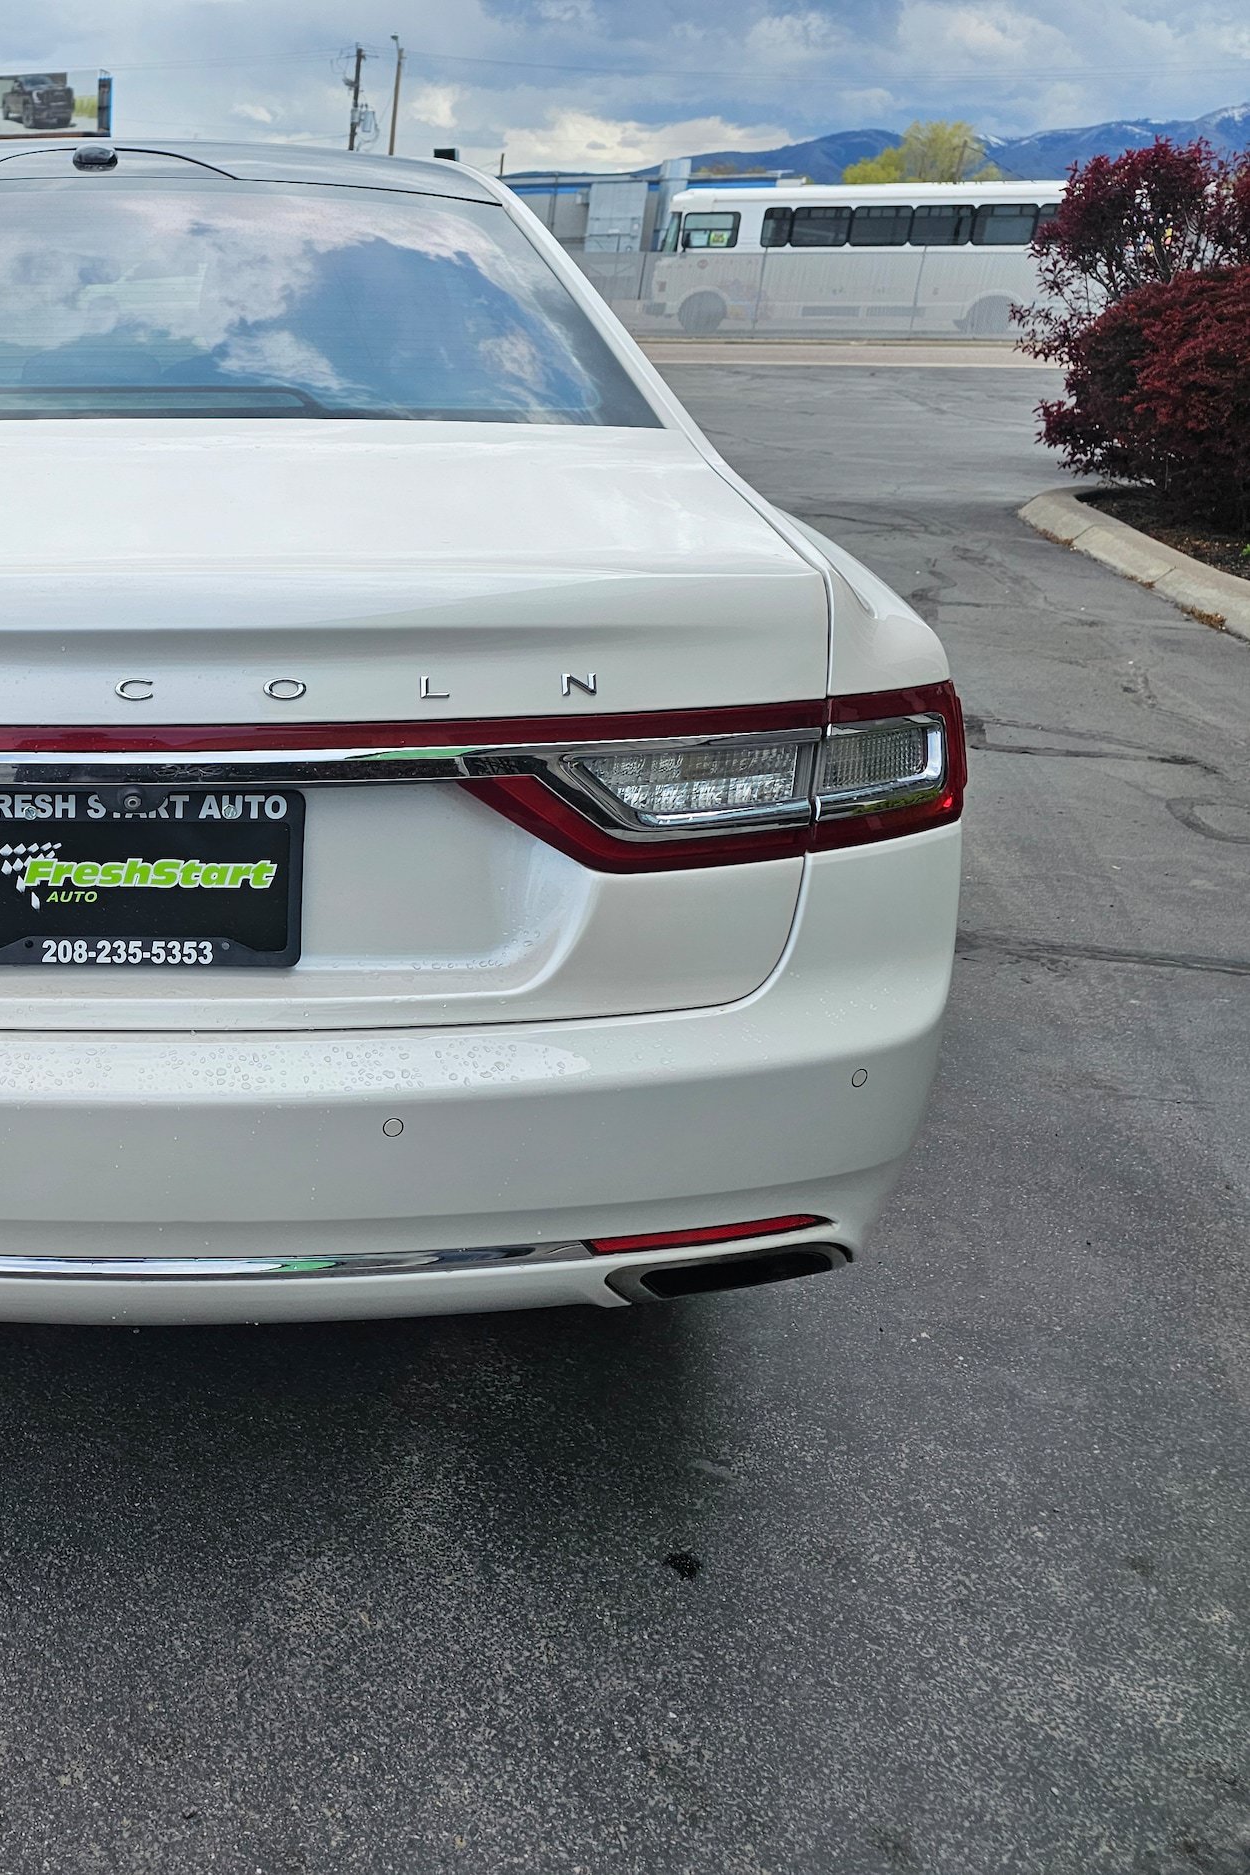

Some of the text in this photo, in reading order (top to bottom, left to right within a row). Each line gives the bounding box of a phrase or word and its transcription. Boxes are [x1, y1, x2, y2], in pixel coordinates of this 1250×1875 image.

[87, 794, 190, 819] SRT
[199, 794, 288, 819] AUTO
[24, 857, 278, 888] FreshStart
[46, 891, 98, 903] AUTO
[41, 939, 215, 966] 208-235-5353
